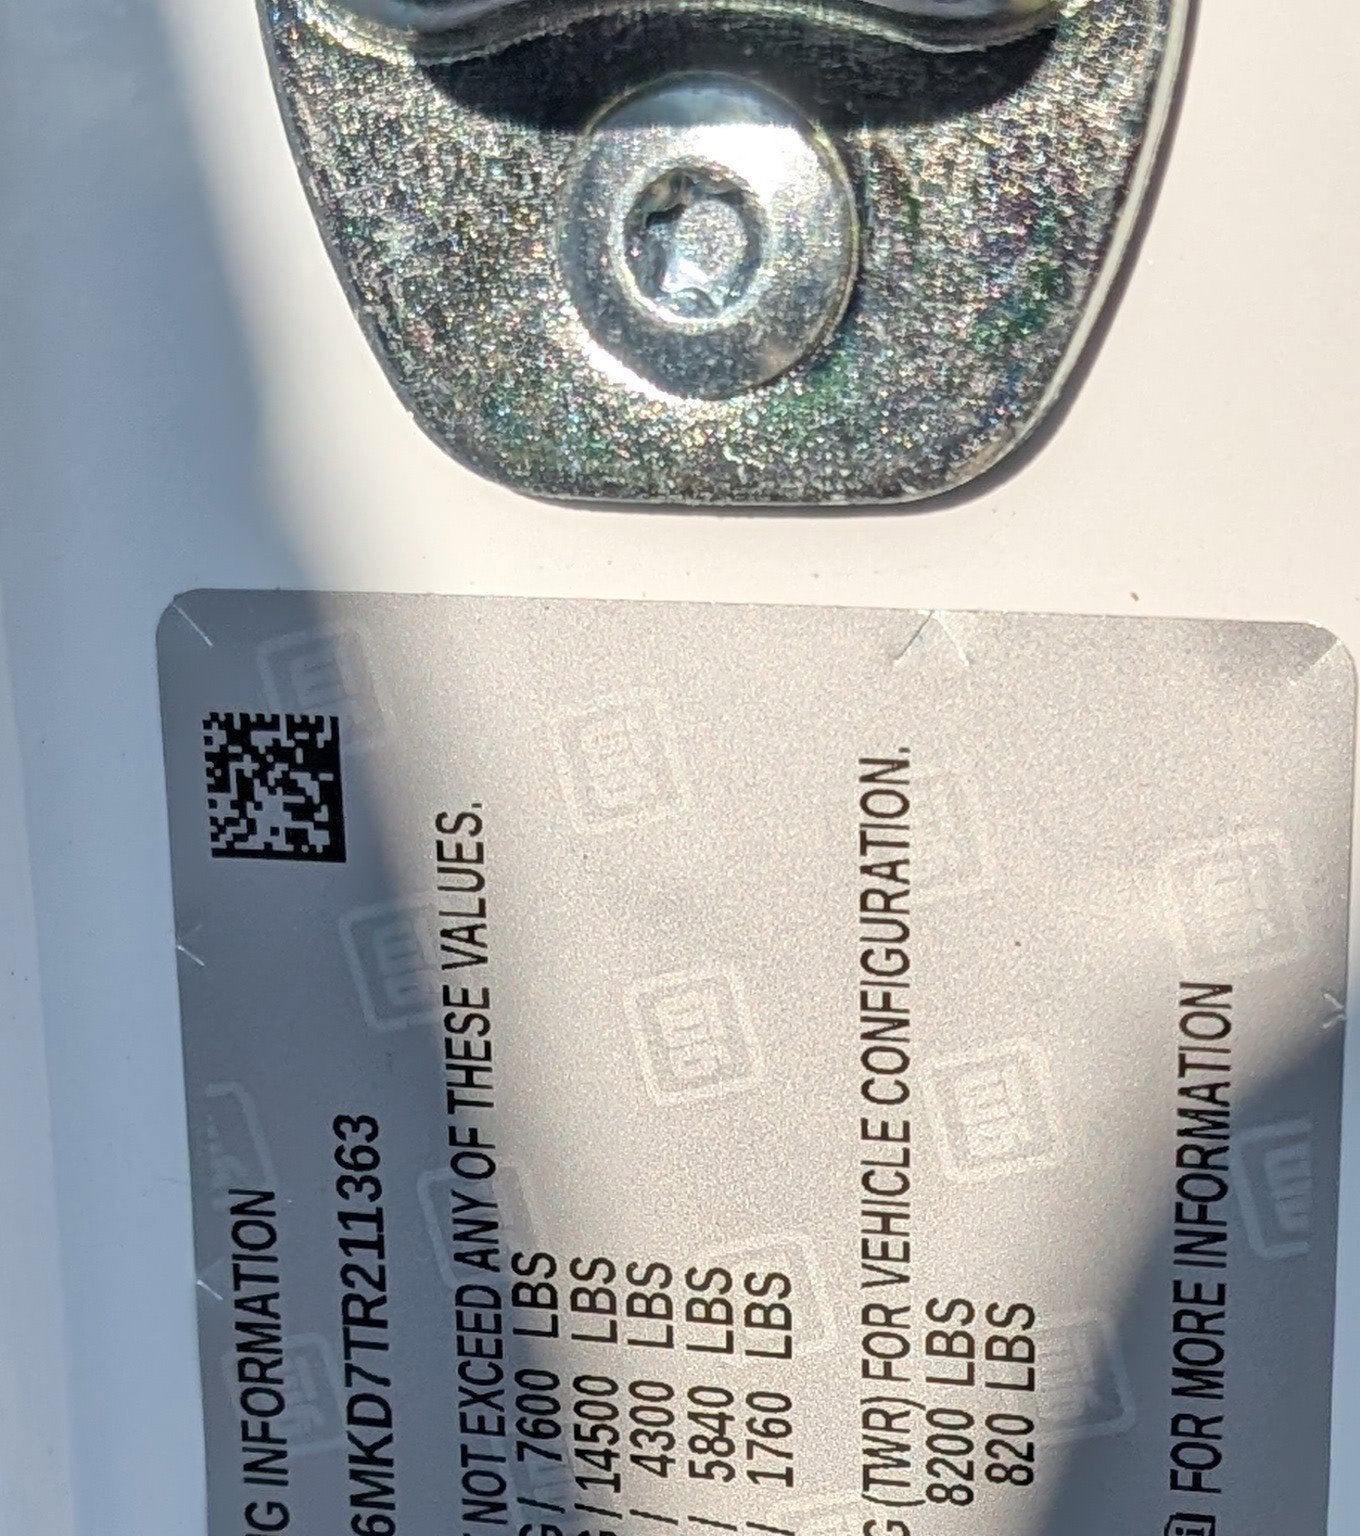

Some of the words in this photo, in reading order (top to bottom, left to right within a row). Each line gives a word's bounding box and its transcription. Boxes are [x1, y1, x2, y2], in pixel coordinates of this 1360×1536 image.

[435, 803, 488, 970] VALUES.
[859, 748, 910, 1105] CONFIGURATION.
[443, 985, 494, 1115] THESE
[448, 1126, 496, 1180] OF
[1173, 982, 1233, 1268] INFORMATION
[451, 1189, 500, 1272] ANY
[861, 1118, 910, 1288] VEHICLE
[228, 1189, 289, 1486] INFORMATION
[511, 1252, 559, 1338] LBS
[570, 1257, 617, 1343] LBS
[626, 1262, 674, 1348] LBS
[685, 1267, 734, 1354] LBS
[744, 1272, 792, 1359] LBS
[926, 1298, 975, 1386] LBS
[1171, 1280, 1226, 1399] MORE
[455, 1285, 505, 1436] EXCEED
[862, 1304, 910, 1382] FOR
[985, 1303, 1035, 1392] LBS
[514, 1369, 562, 1462] 7600
[573, 1375, 621, 1493] 14500
[629, 1380, 675, 1478] 4300
[687, 1386, 735, 1482] 5840
[746, 1391, 793, 1487] 1760
[860, 1396, 925, 1507] (TWR)
[926, 1408, 974, 1506] 8200
[985, 1414, 1034, 1486] 820
[1170, 1413, 1223, 1494] FOR
[460, 1444, 508, 1525] NOT
